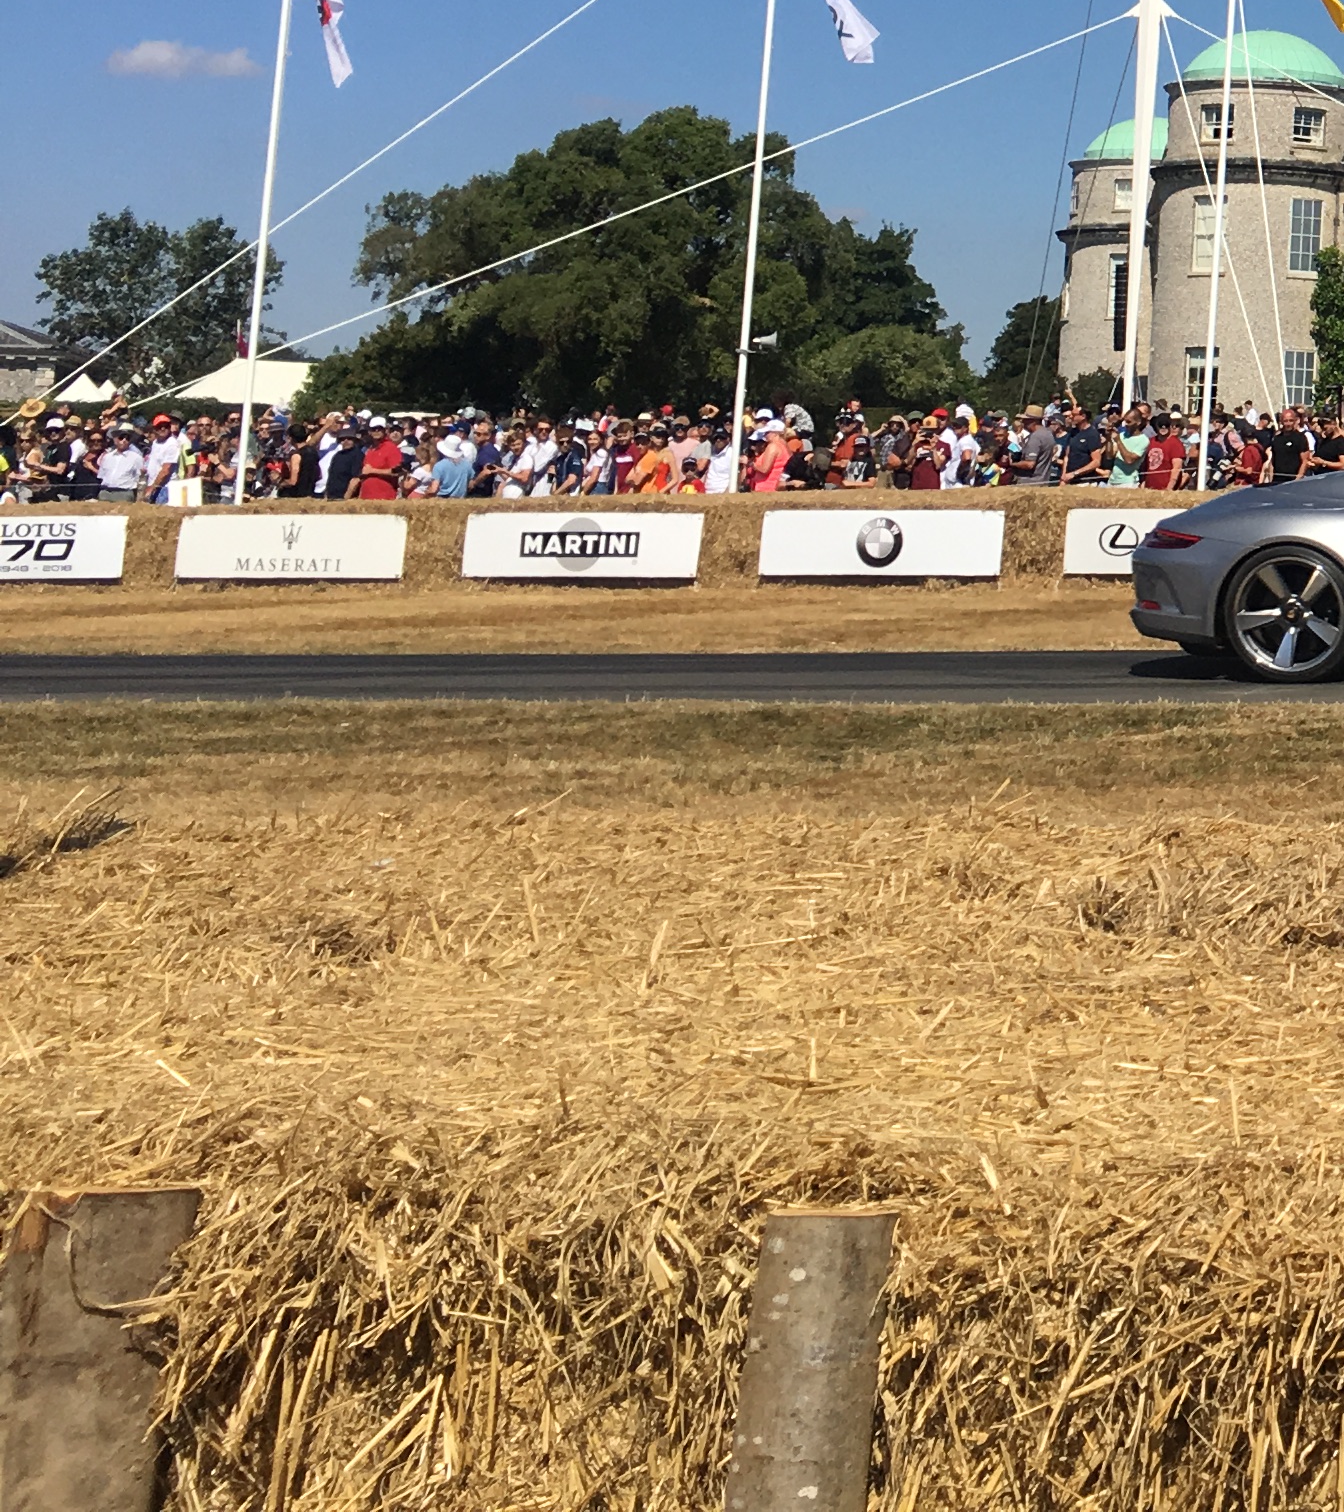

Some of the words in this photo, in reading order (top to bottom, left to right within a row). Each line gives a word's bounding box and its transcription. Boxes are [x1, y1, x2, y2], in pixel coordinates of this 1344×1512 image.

[1, 522, 77, 538] LOTUS
[861, 518, 900, 536] BMW
[0, 538, 76, 562] 70
[523, 534, 637, 555] MARTINI
[234, 557, 342, 573] MASERATI
